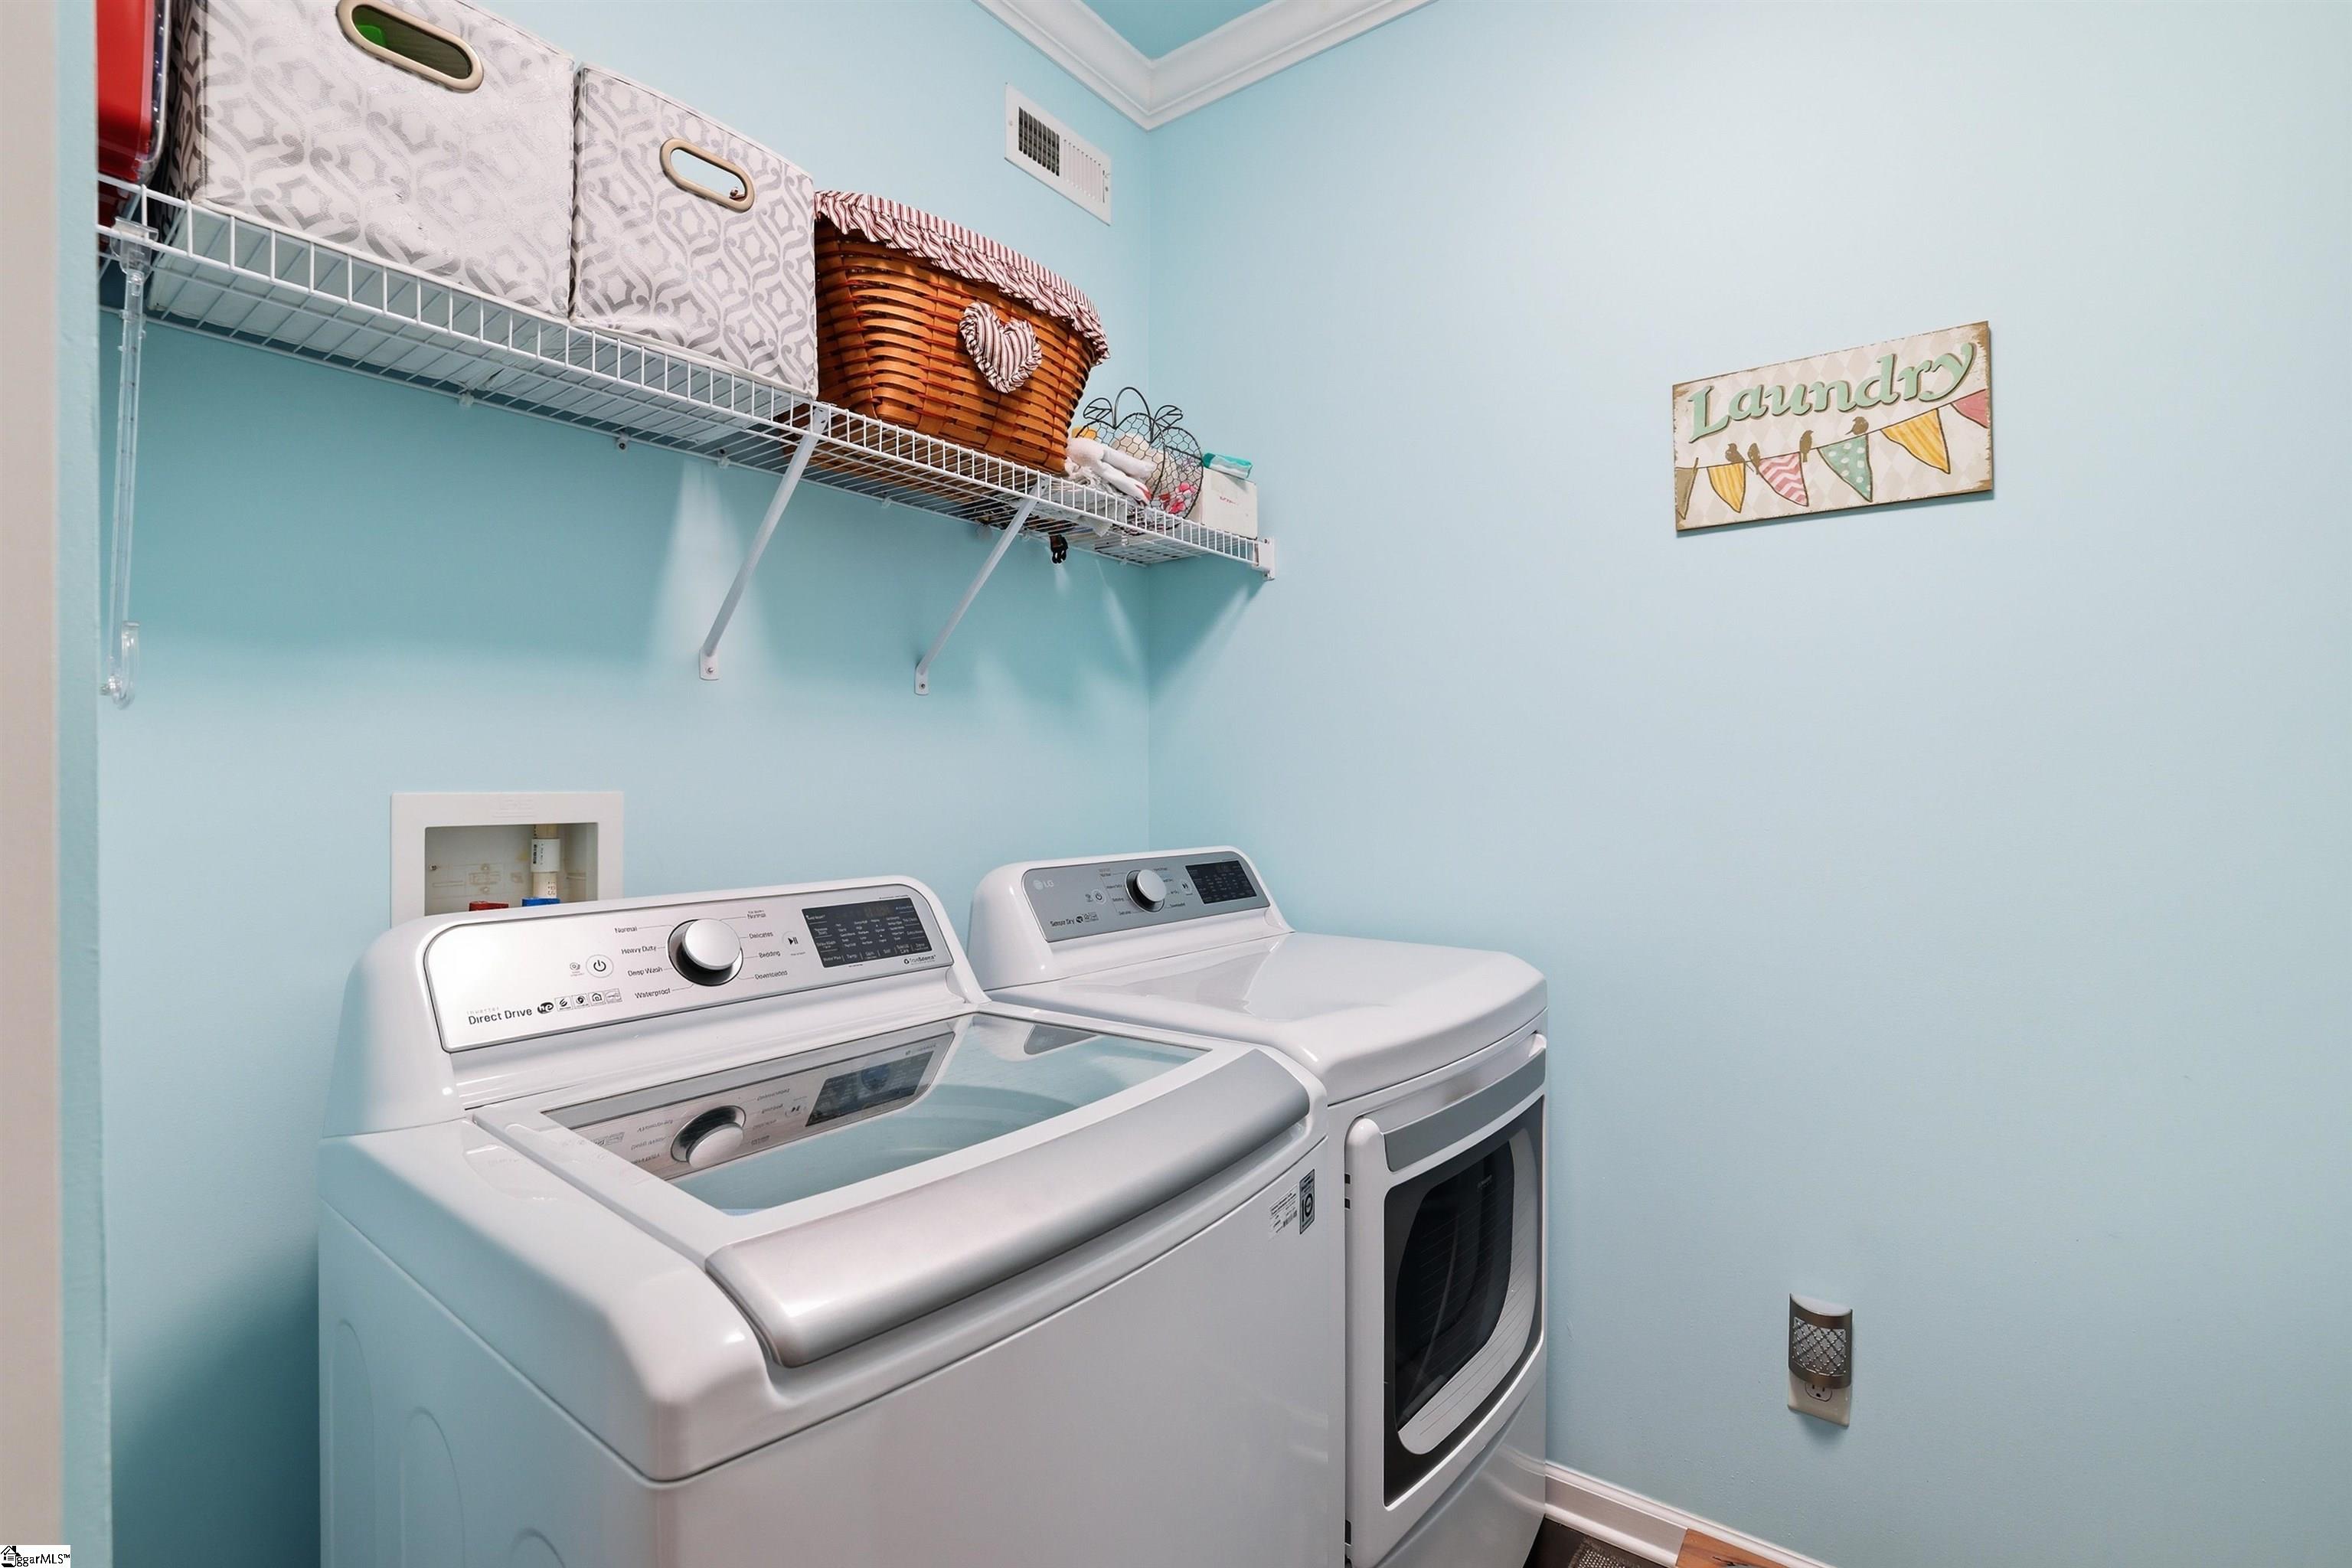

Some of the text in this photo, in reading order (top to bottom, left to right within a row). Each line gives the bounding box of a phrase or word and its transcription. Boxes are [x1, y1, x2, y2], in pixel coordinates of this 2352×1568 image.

[1688, 341, 1977, 444] Laundry
[614, 925, 638, 934] Normal
[620, 946, 642, 955] Heavy
[627, 965, 664, 977] Deep Wash
[468, 1011, 502, 1025] Direct
[504, 1008, 533, 1020] Drive
